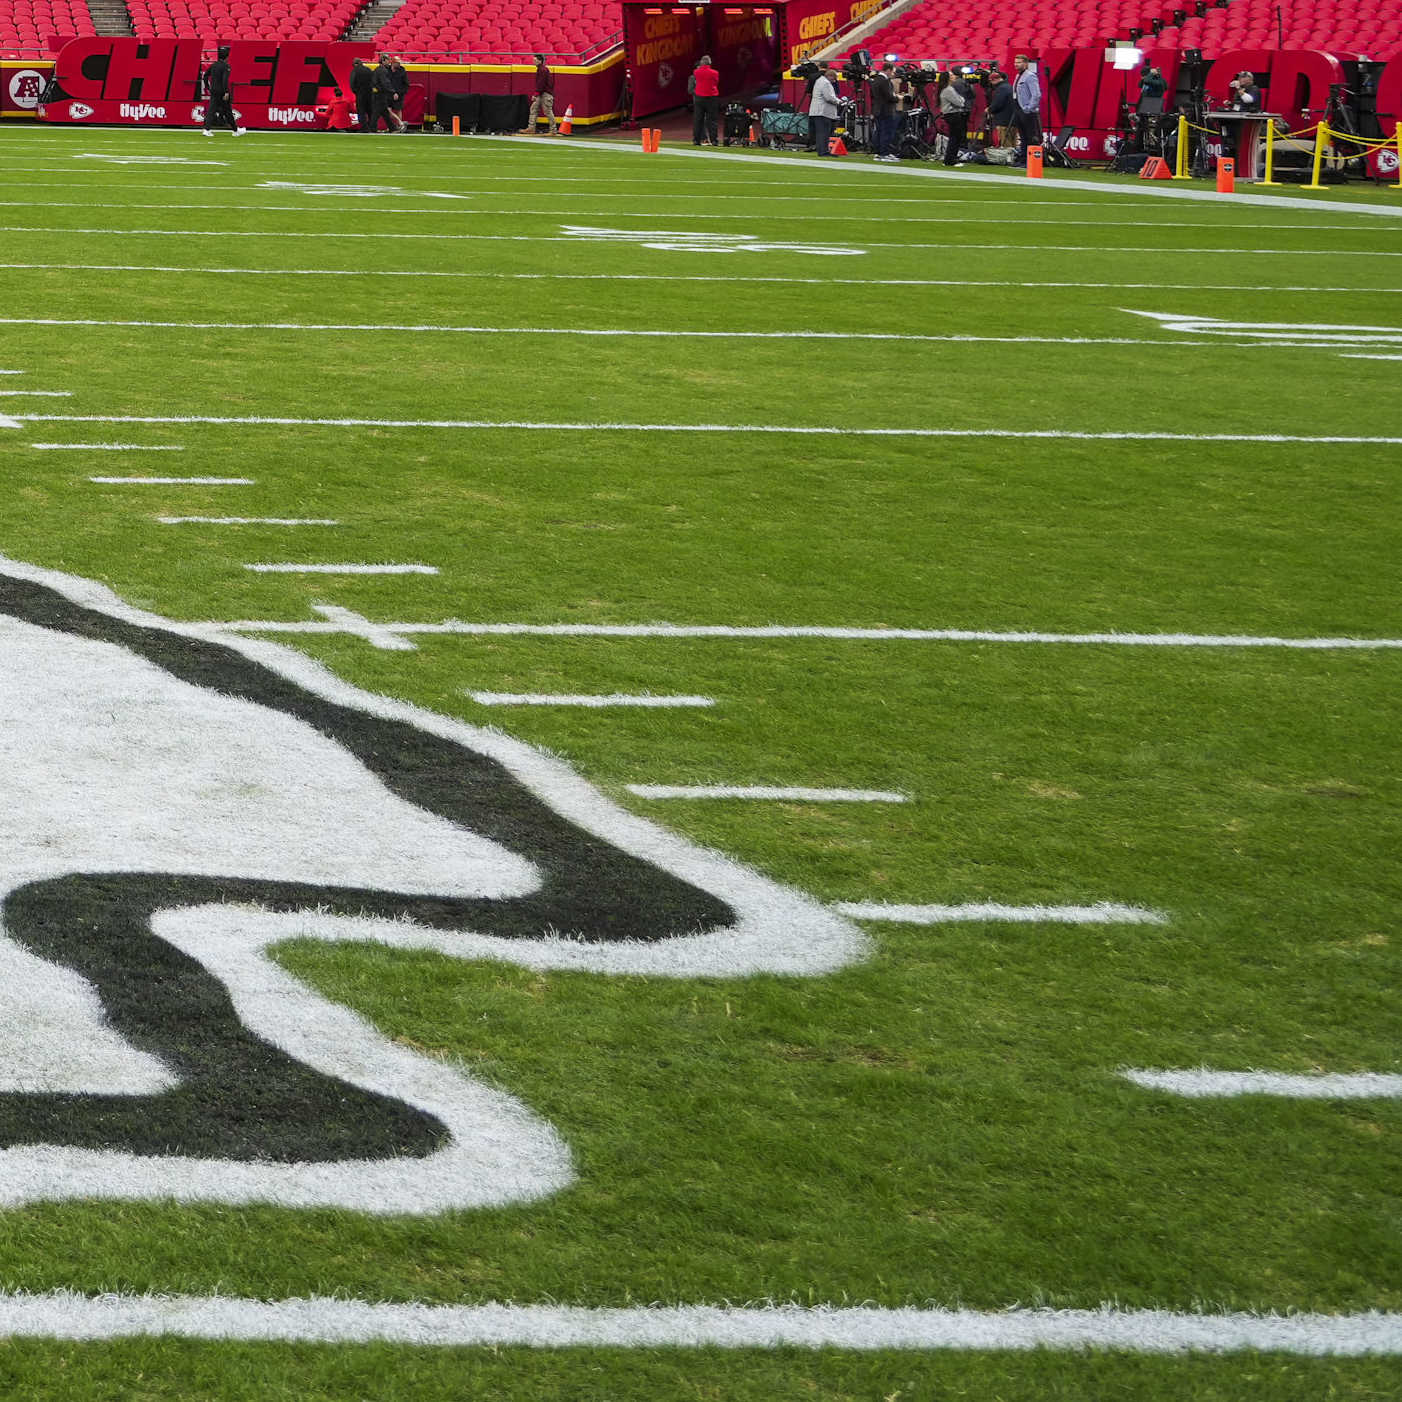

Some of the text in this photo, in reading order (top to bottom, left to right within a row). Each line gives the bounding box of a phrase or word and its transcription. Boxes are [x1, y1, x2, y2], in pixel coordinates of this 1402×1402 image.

[644, 14, 681, 39] CHIEFS
[800, 12, 836, 40] CHIEFS
[636, 33, 694, 66] KINGDOM
[55, 36, 376, 106] CHIEFS
[1146, 160, 1157, 177] 10
